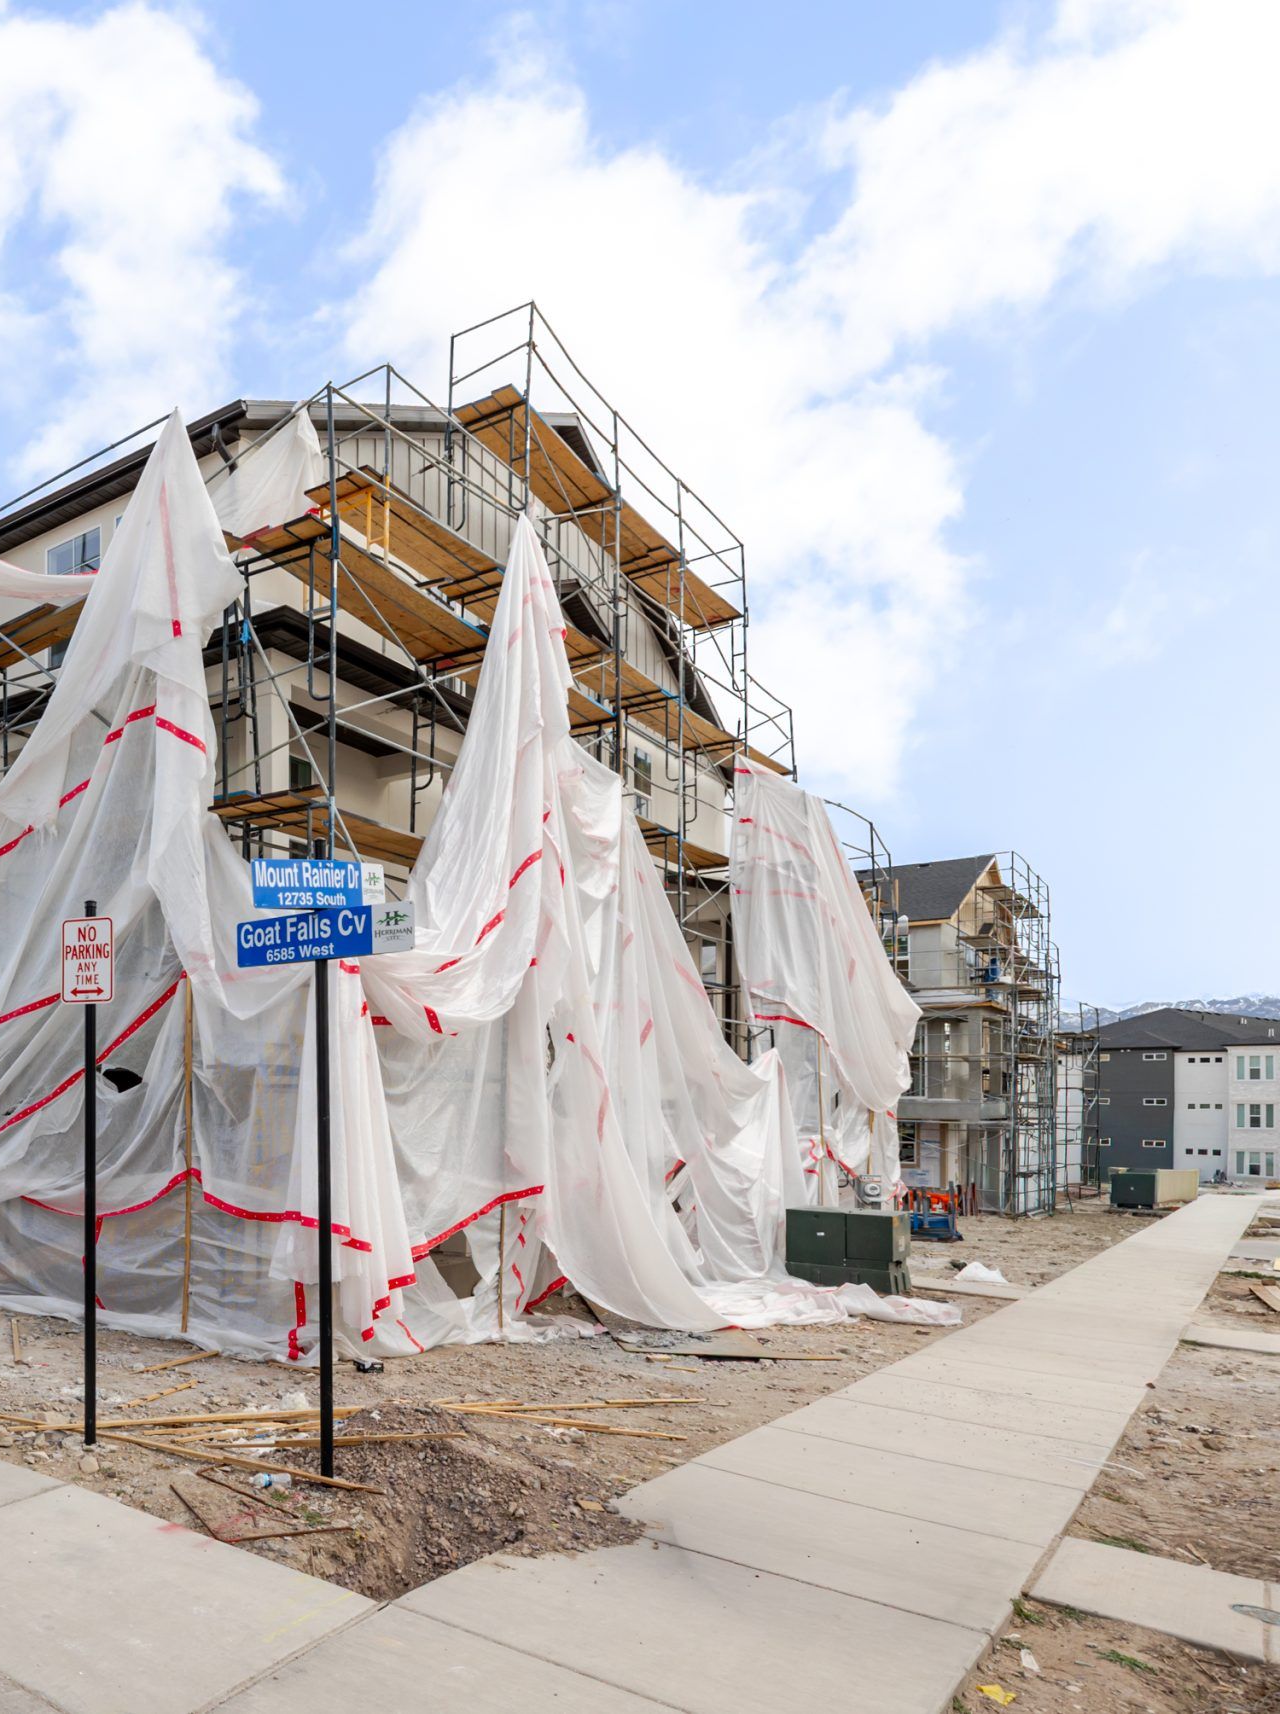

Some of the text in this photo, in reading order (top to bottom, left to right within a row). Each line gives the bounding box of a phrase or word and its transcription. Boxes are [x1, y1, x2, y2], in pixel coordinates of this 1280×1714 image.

[254, 861, 360, 889] Mount Rainier Dr
[277, 892, 313, 906] 12735
[316, 892, 347, 906] South
[78, 926, 97, 942] NO
[240, 910, 366, 949] Goat Falls Cv
[374, 926, 413, 938] HERRIMAN
[65, 943, 109, 960] PARKING
[266, 942, 335, 962] 6585 West
[77, 961, 97, 973] ANY
[75, 973, 99, 985] TIME
